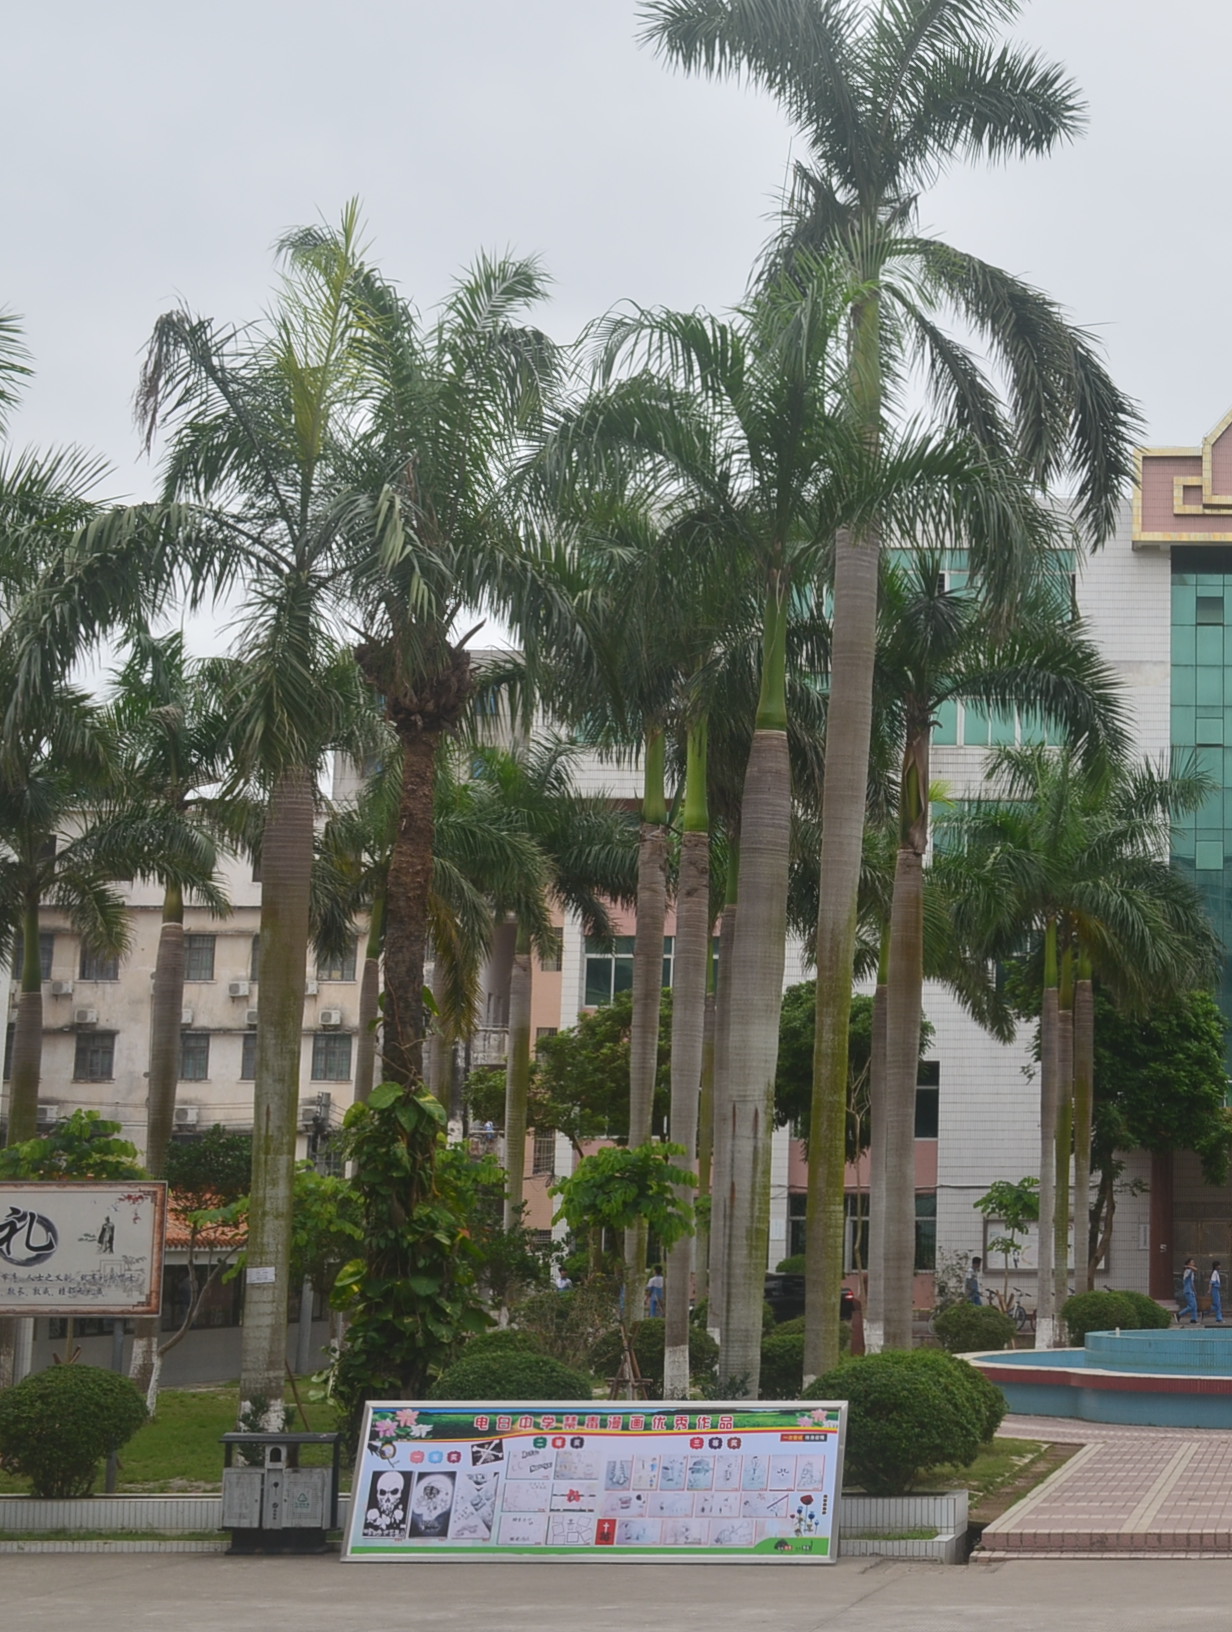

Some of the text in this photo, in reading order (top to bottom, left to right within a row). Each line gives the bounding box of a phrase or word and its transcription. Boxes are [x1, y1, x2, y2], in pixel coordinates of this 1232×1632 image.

[0, 1207, 56, 1256] 礼
[474, 1415, 734, 1430] 电白中学禁毒漫画优秀作品
